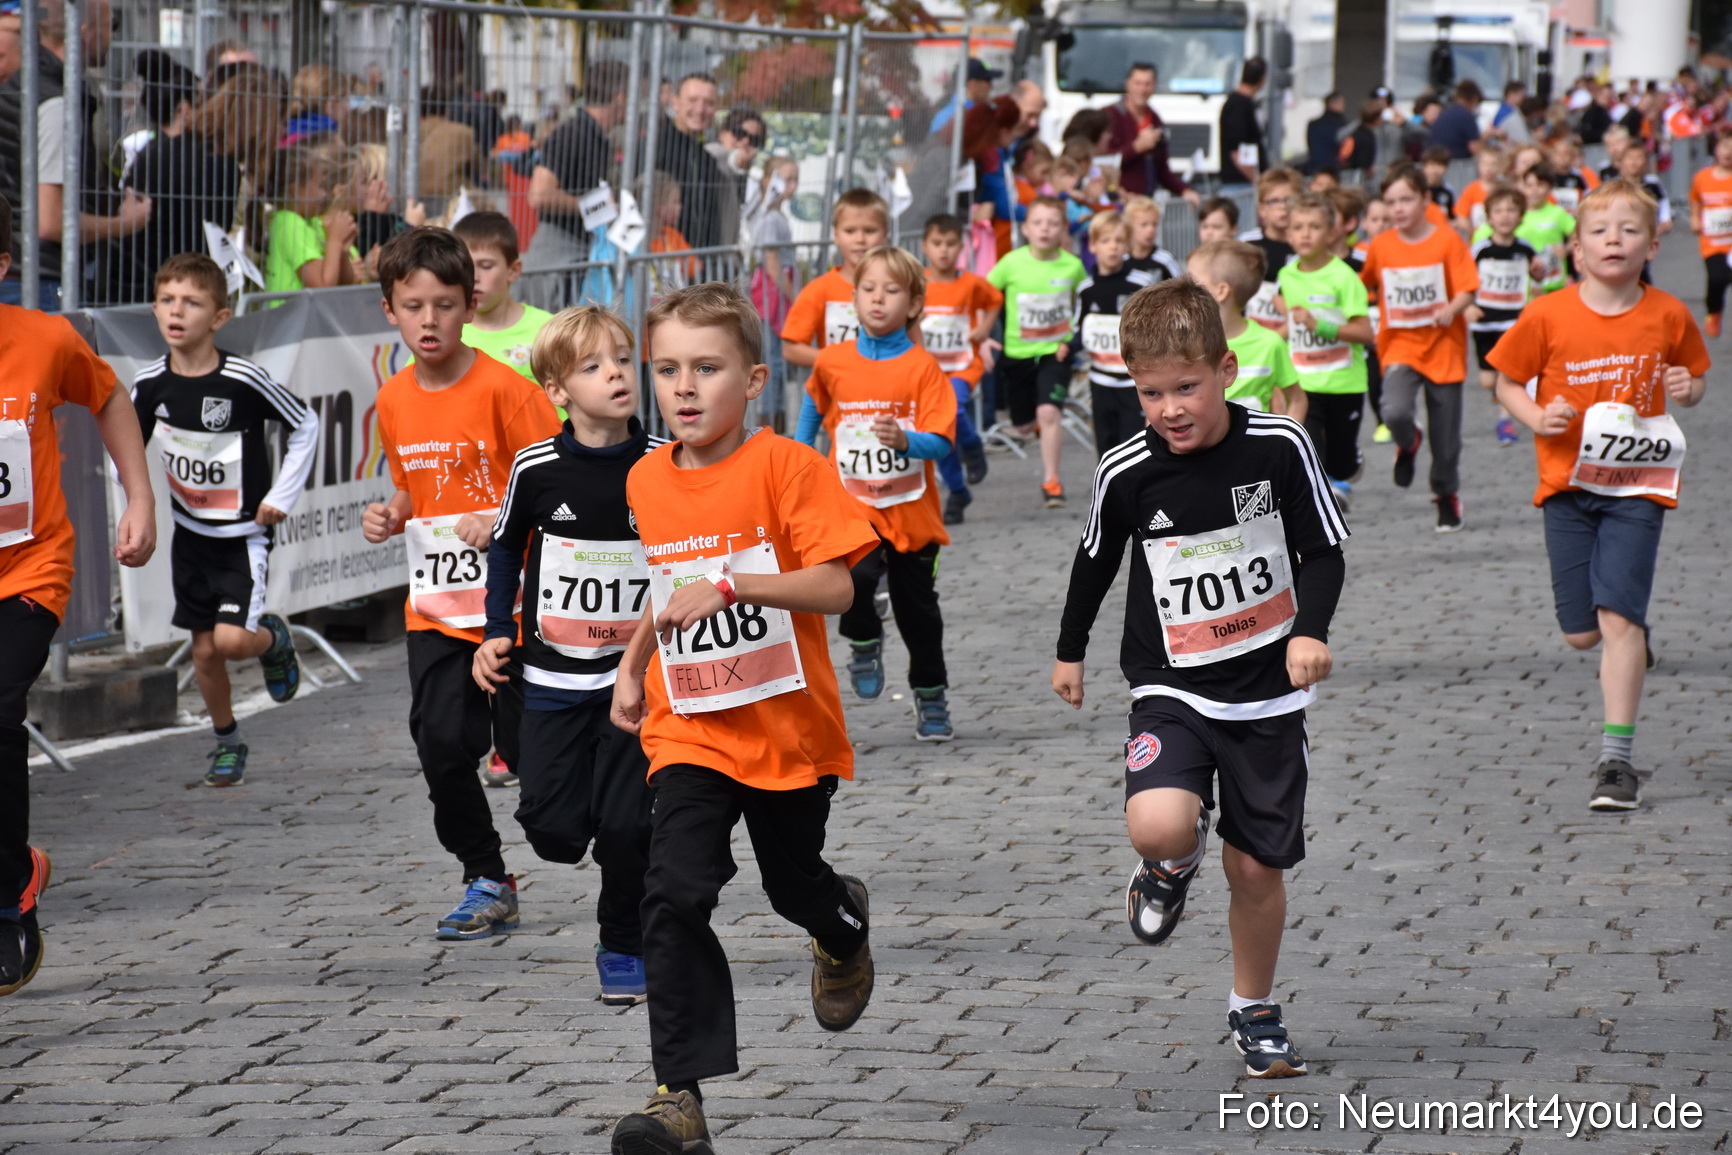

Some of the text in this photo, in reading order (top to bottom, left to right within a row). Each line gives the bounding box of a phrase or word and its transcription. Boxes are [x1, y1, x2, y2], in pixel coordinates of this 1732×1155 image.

[1395, 284, 1436, 304] 7005
[1092, 333, 1118, 349] 701
[1565, 353, 1636, 372] Neumarkter
[1567, 367, 1624, 385] Stadtlauf
[1599, 433, 1671, 462] 7229
[163, 450, 225, 485] 7096
[848, 448, 909, 474] 7195
[1594, 467, 1642, 484] FINN
[551, 513, 577, 521] adidas
[1149, 520, 1174, 530] adidas
[1195, 535, 1245, 555] BOCK
[424, 549, 485, 586] 723
[587, 552, 633, 563] BOCK
[558, 575, 650, 613] 7017
[1169, 556, 1274, 615] 7013
[588, 626, 618, 639] Nick
[1210, 616, 1257, 638] Tobias
[675, 658, 744, 692] FELIX
